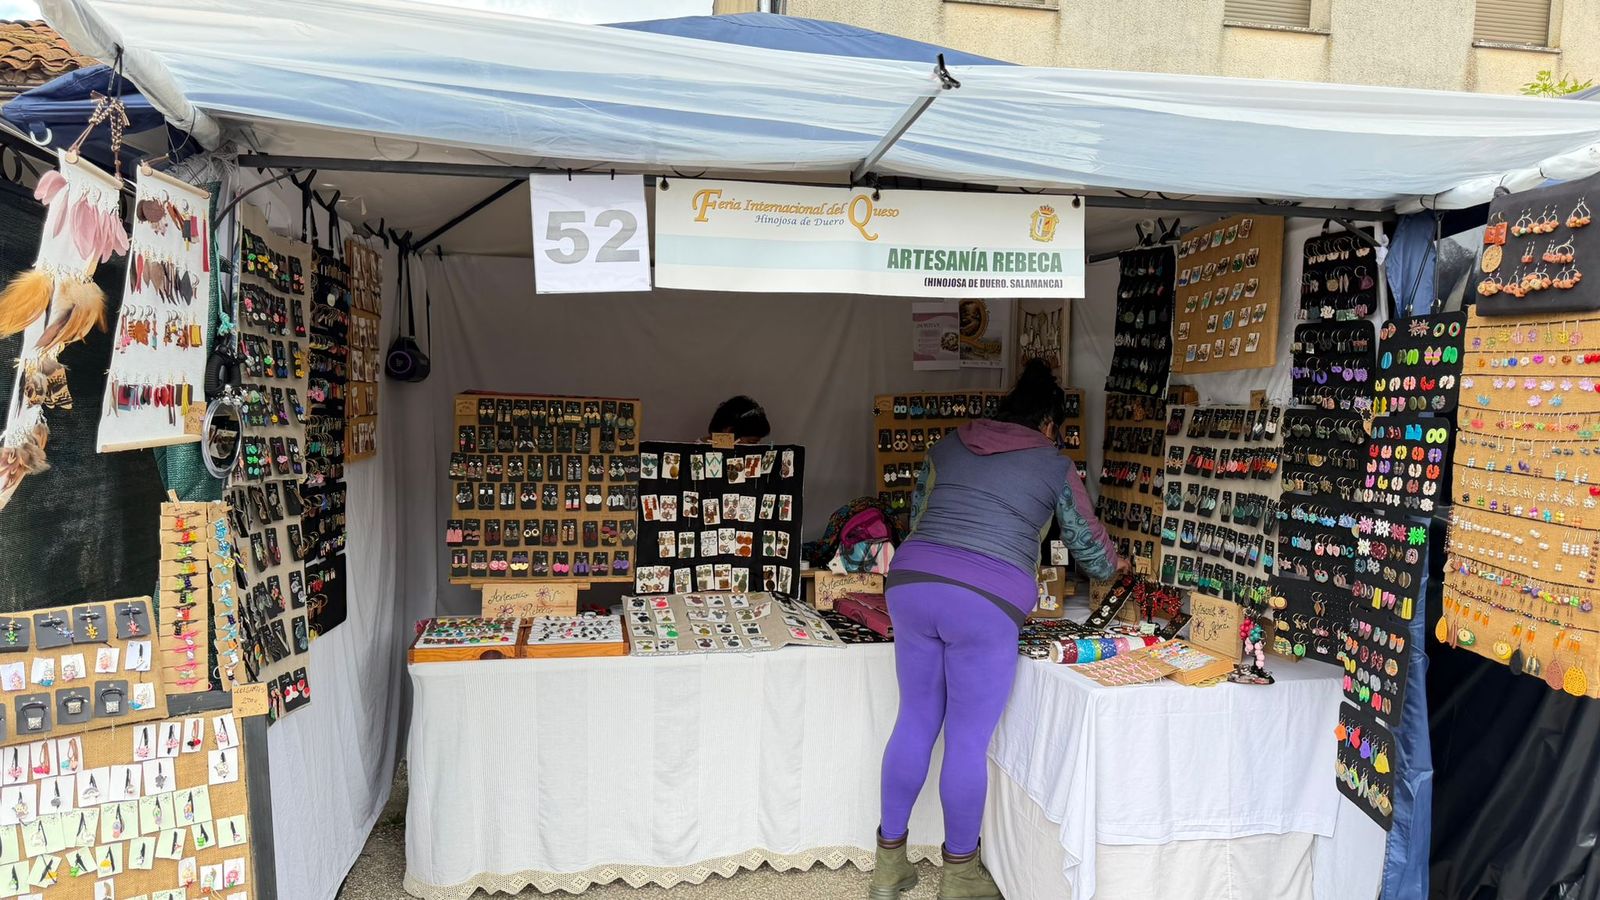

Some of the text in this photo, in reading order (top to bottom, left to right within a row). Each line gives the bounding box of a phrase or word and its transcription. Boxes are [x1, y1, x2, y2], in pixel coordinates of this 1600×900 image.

[692, 189, 899, 241] Feria Internacional del Queso
[755, 214, 845, 227] Hinojosa de Duero
[544, 209, 640, 264] 52
[887, 247, 1063, 273] ARTESANÍA REBECA
[924, 277, 967, 288] (HINOJOSA
[968, 278, 978, 288] DE
